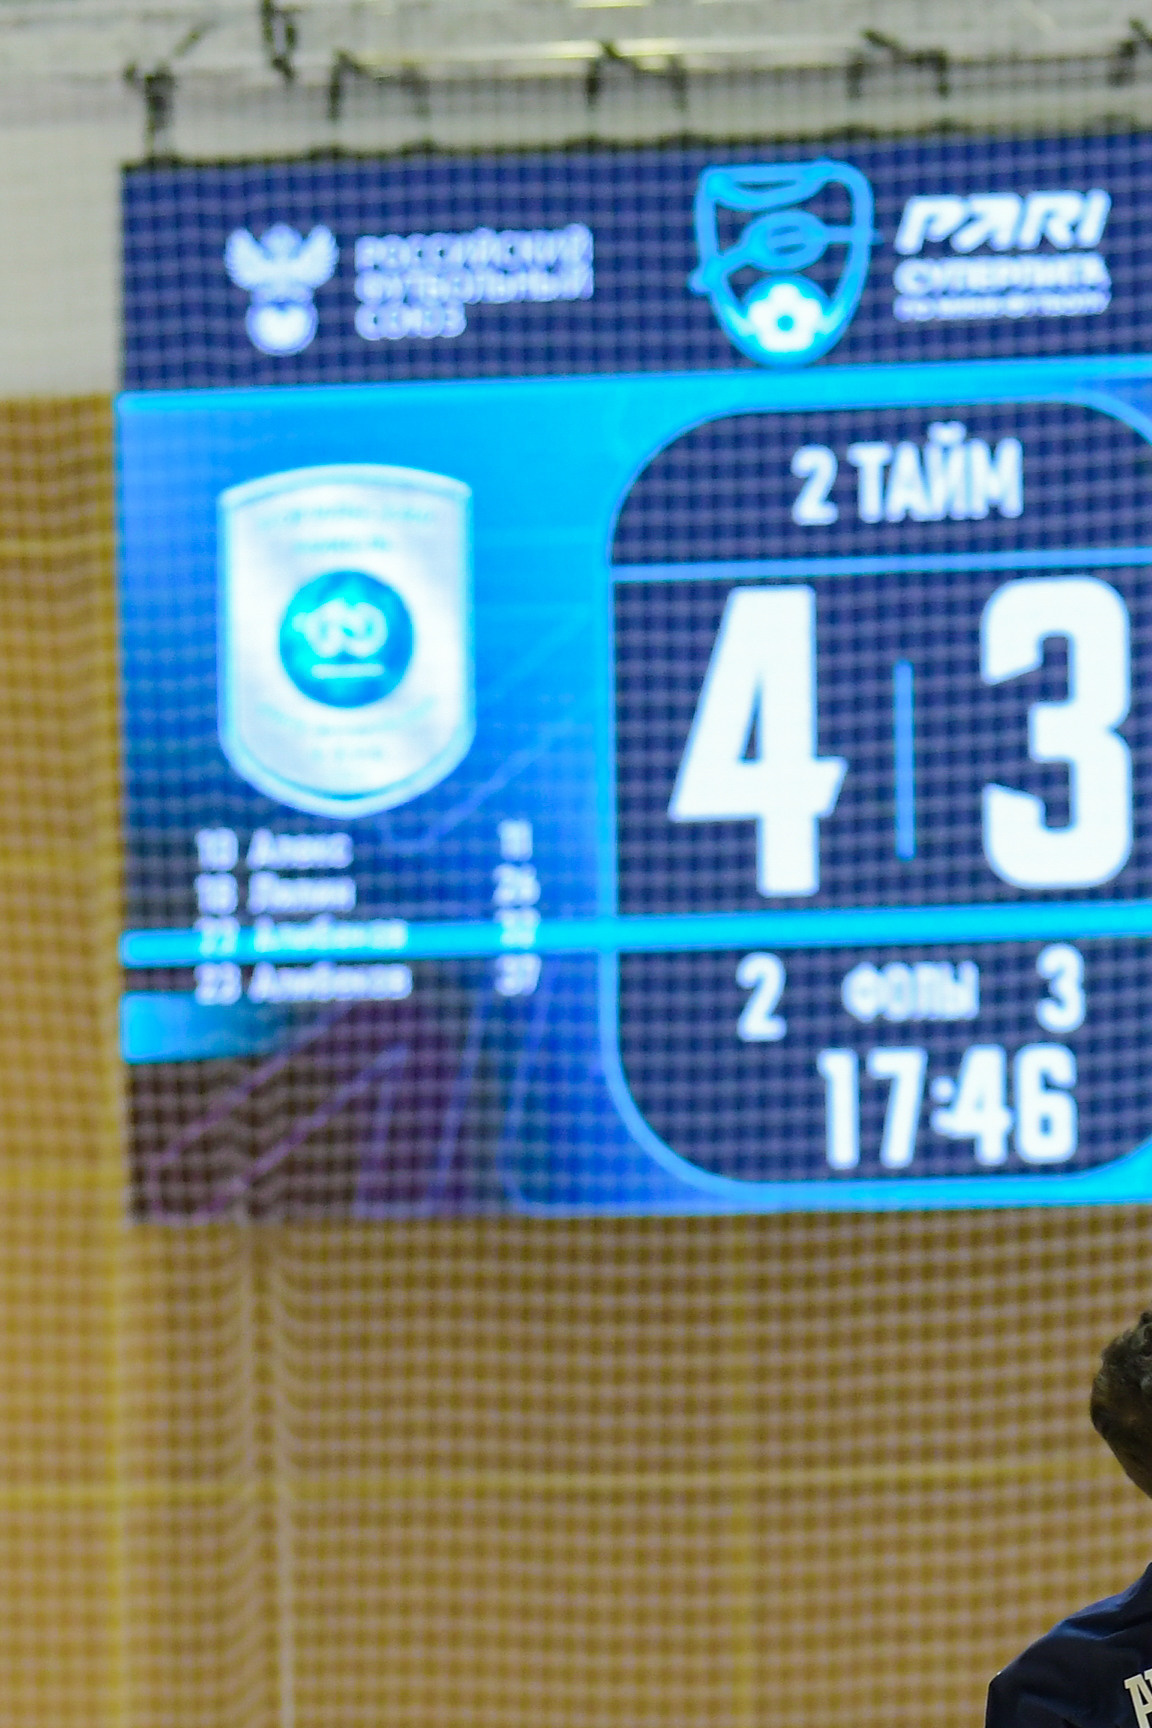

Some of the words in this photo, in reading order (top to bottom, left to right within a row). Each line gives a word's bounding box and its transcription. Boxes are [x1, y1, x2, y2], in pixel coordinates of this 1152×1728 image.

[894, 189, 1111, 254] PARI
[790, 445, 838, 526] 2
[846, 420, 1024, 524] ТАЙМ
[667, 583, 848, 898] 4
[979, 574, 1134, 890] 3
[736, 952, 787, 1042] 2
[1035, 942, 1086, 1034] 3
[817, 1042, 1078, 1170] 17:46
